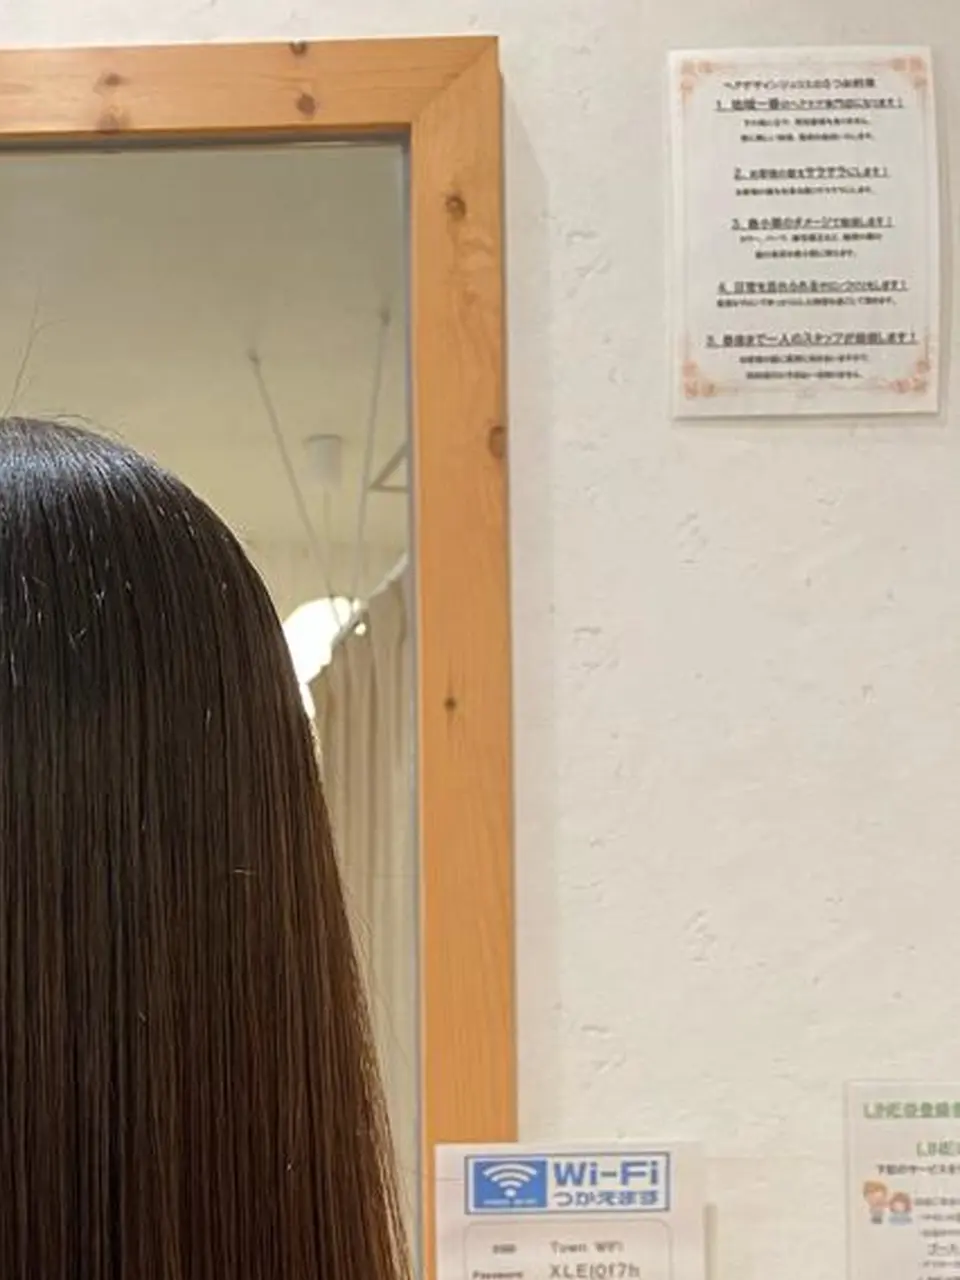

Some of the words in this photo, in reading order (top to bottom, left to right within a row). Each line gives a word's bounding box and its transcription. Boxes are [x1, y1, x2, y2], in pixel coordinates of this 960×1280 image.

[553, 1160, 659, 1187] Wi-Fi
[553, 1189, 659, 1206] つかえます
